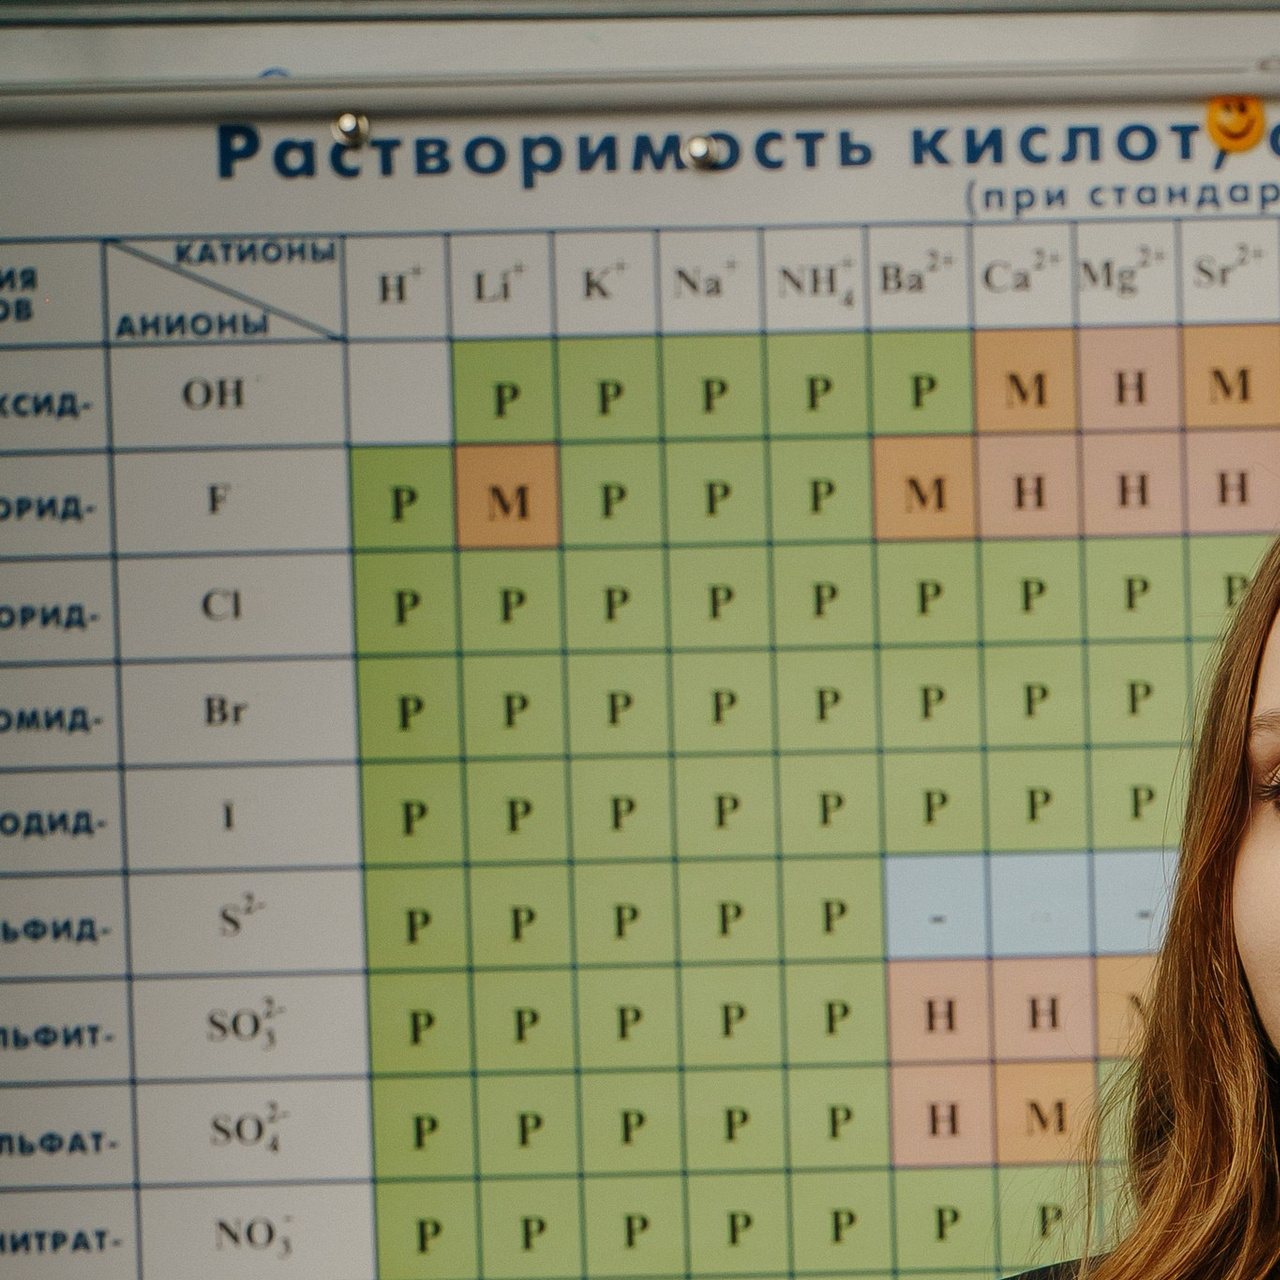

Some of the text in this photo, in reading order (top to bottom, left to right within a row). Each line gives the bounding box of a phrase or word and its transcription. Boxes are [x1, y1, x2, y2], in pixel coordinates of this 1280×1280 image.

[217, 122, 873, 188] Растворимость
[966, 179, 1067, 217] (при
[174, 238, 337, 266] КАТИОНЫ
[115, 311, 271, 340] АНИОНЫ
